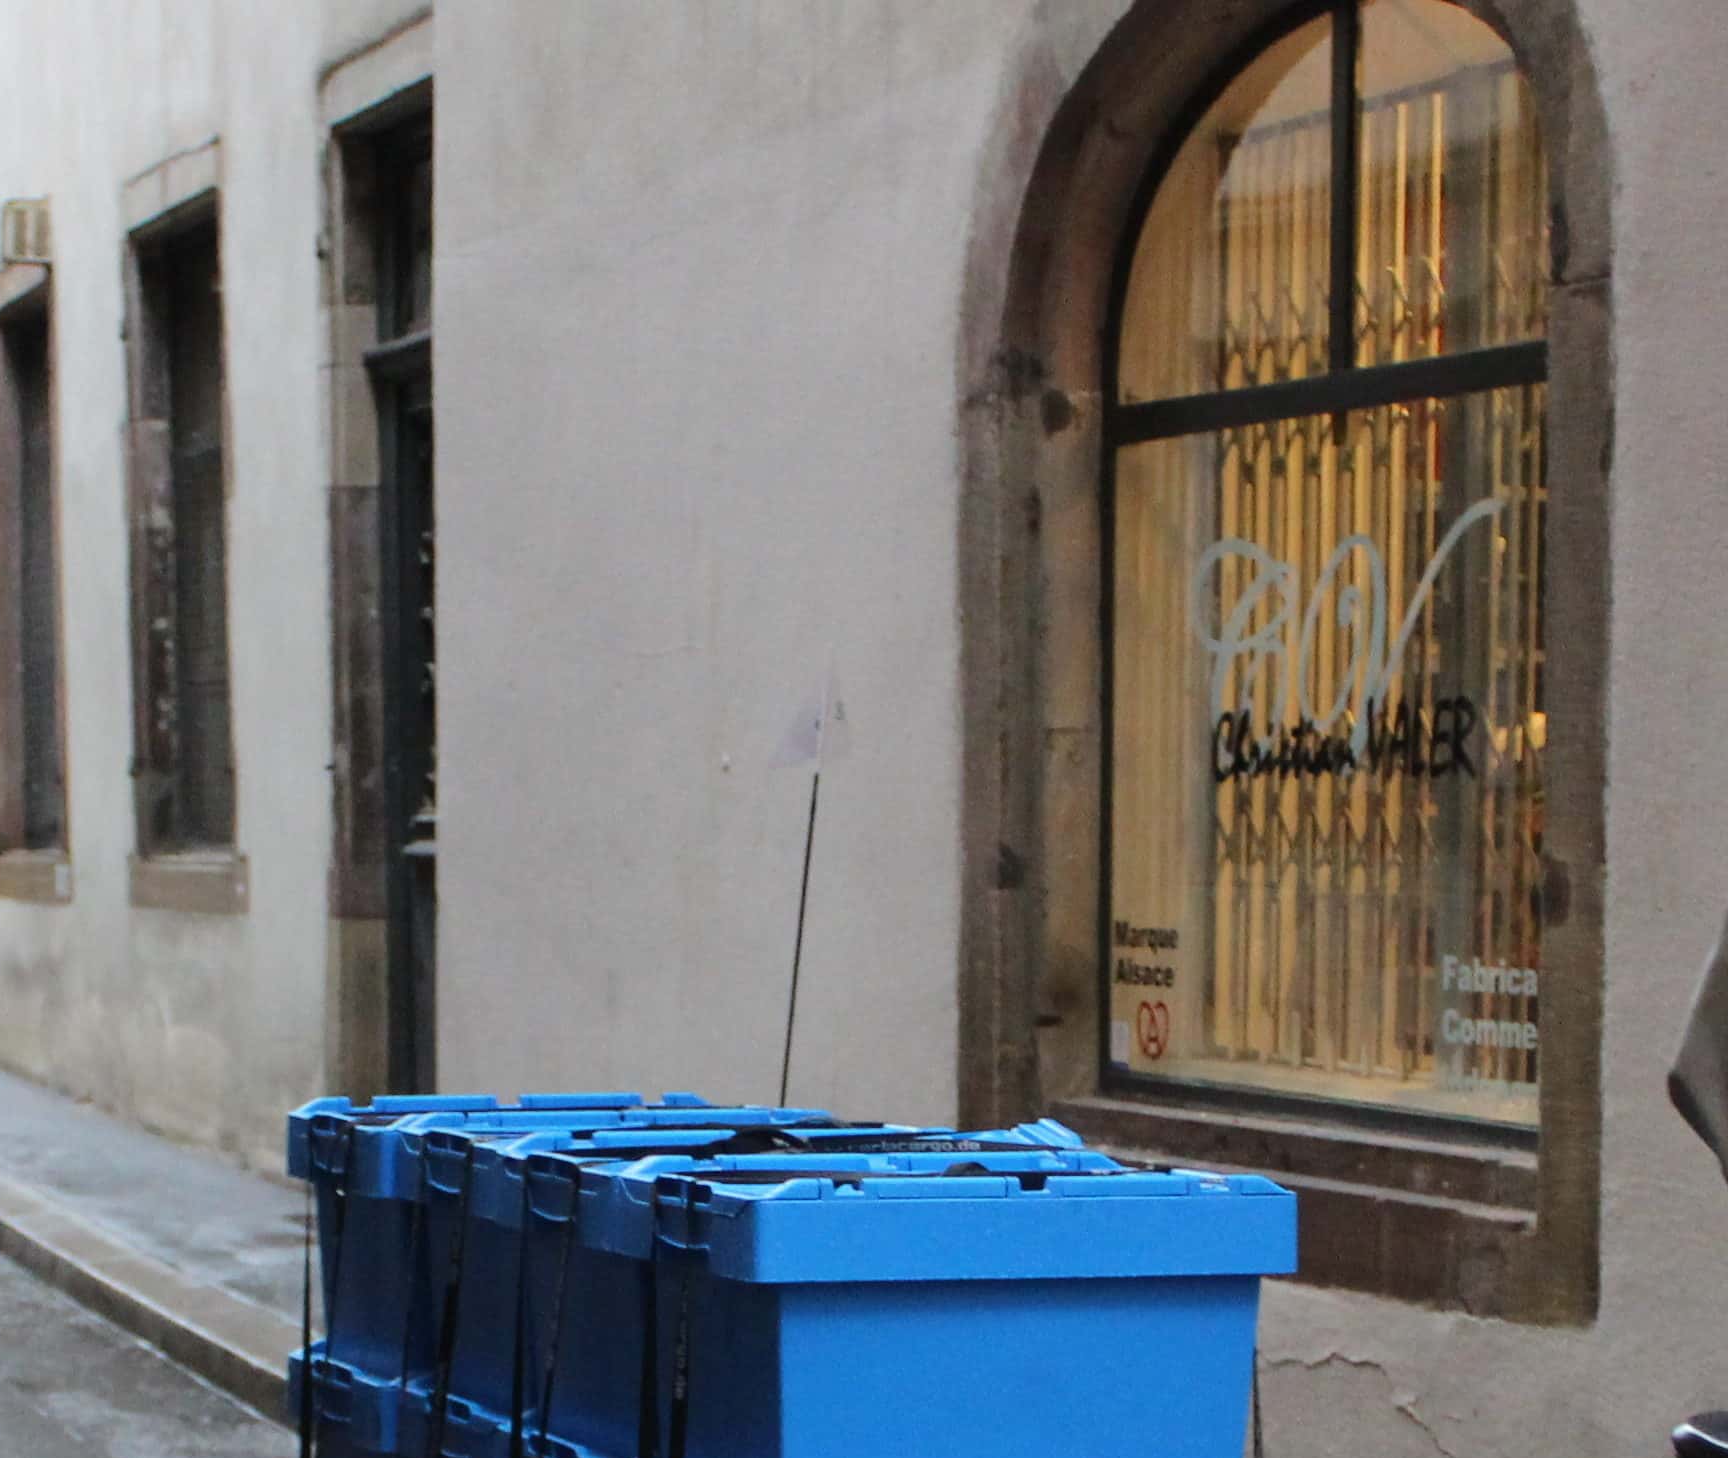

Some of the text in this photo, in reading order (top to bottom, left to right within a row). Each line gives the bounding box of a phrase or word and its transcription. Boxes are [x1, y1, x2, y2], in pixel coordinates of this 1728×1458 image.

[1366, 694, 1477, 779] VALER
[1115, 920, 1179, 955] Marque
[1114, 958, 1174, 988] Alsace
[1442, 954, 1538, 997] Fabrica
[1440, 1008, 1538, 1050] Comme
